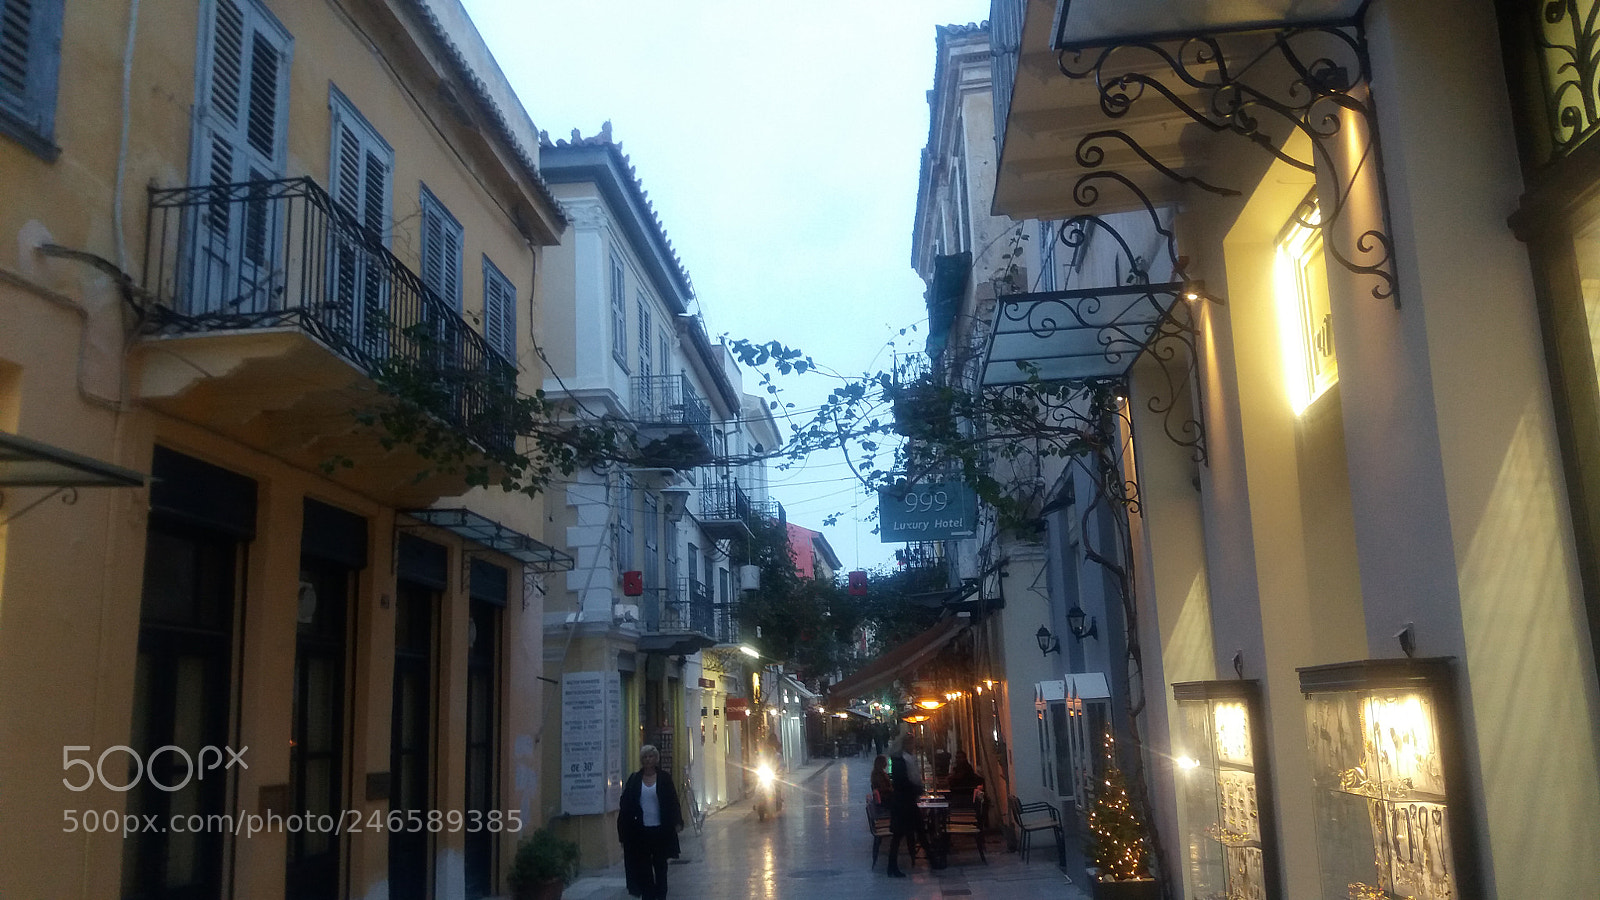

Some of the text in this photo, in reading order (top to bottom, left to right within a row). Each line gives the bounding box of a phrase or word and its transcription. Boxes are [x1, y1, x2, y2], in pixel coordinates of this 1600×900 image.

[905, 491, 948, 513] 999
[893, 517, 963, 532] Luxury Hotel
